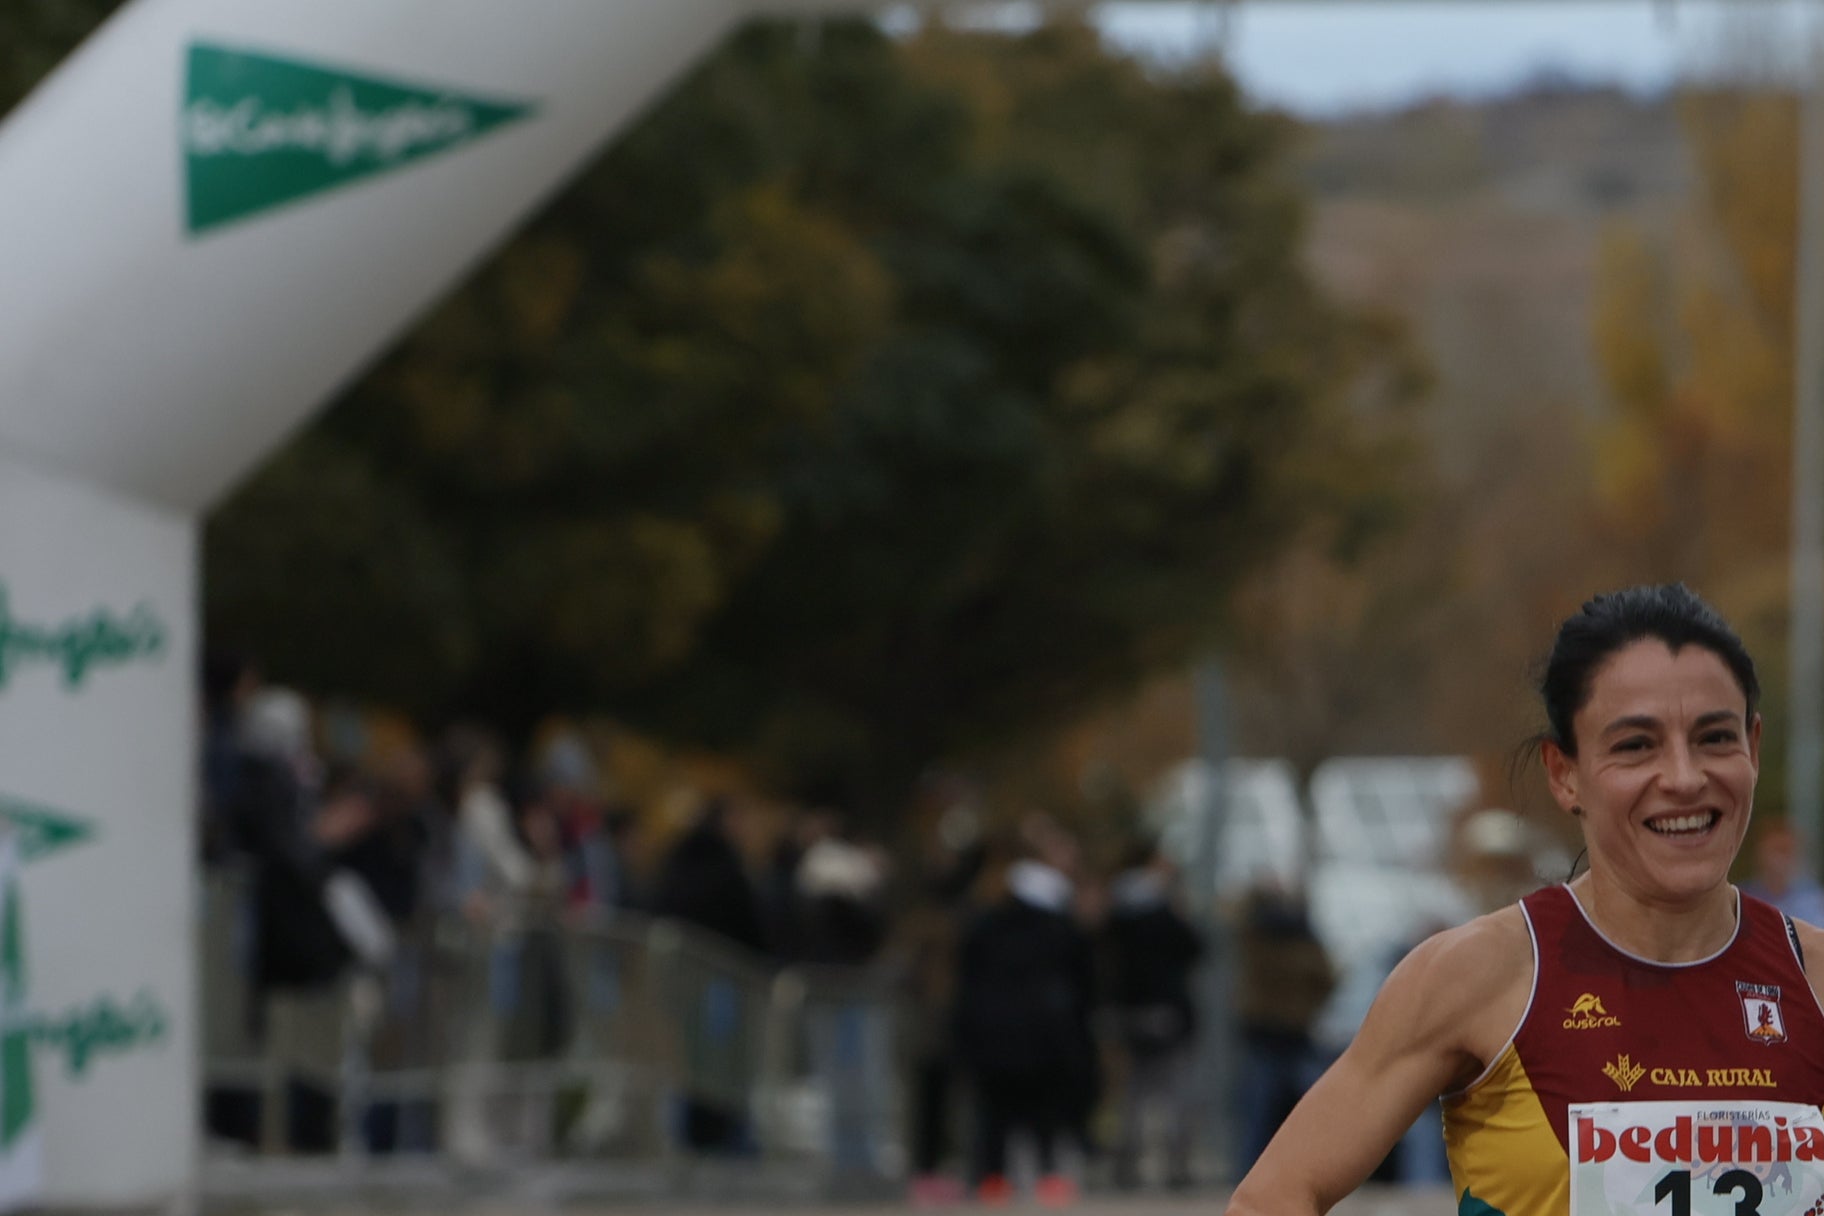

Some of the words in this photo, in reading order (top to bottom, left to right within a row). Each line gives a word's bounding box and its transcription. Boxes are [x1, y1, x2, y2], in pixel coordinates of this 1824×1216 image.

[1563, 1016, 1622, 1029] austral
[1650, 1068, 1702, 1087] CAJA
[1706, 1068, 1777, 1087] RURAL
[1696, 1107, 1771, 1121] FLORISTERÍAS
